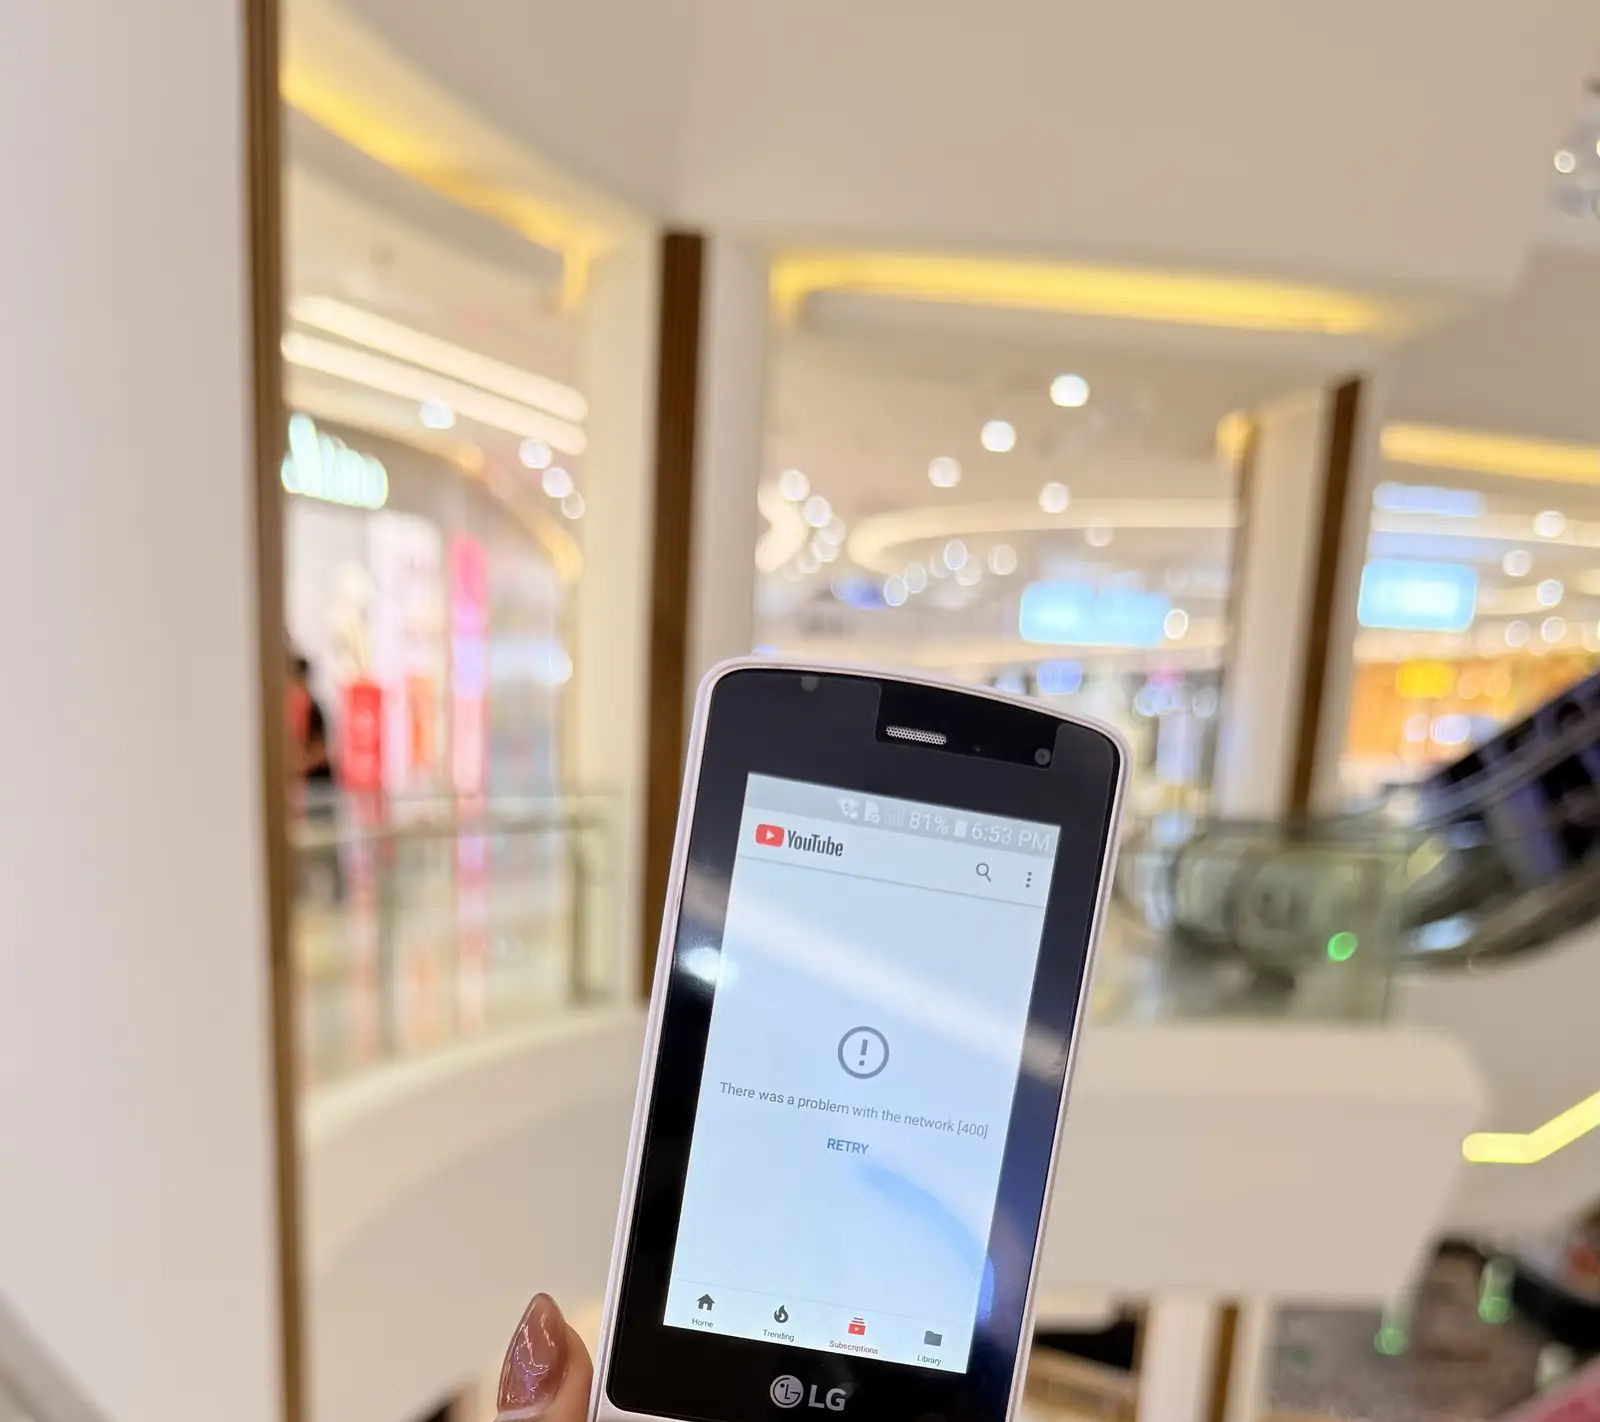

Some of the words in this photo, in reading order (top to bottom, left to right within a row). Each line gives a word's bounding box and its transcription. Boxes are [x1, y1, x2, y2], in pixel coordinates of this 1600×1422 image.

[909, 812, 949, 835] 81%
[971, 822, 1013, 845] 6:53
[1018, 829, 1051, 852] PM
[787, 830, 844, 857] YouTube
[720, 1081, 756, 1099] There
[759, 1091, 785, 1104] was
[787, 1096, 795, 1105] a
[797, 1097, 849, 1115] problem
[852, 1104, 878, 1119] with
[881, 1109, 901, 1123] the
[904, 1115, 955, 1132] network
[956, 1120, 989, 1140] [400]
[827, 1137, 869, 1155] RETRY
[692, 1318, 714, 1328] Home
[763, 1329, 795, 1342] Trending
[829, 1340, 879, 1355] Subscriptions
[916, 1354, 942, 1366] Library
[808, 1384, 847, 1411] LG
